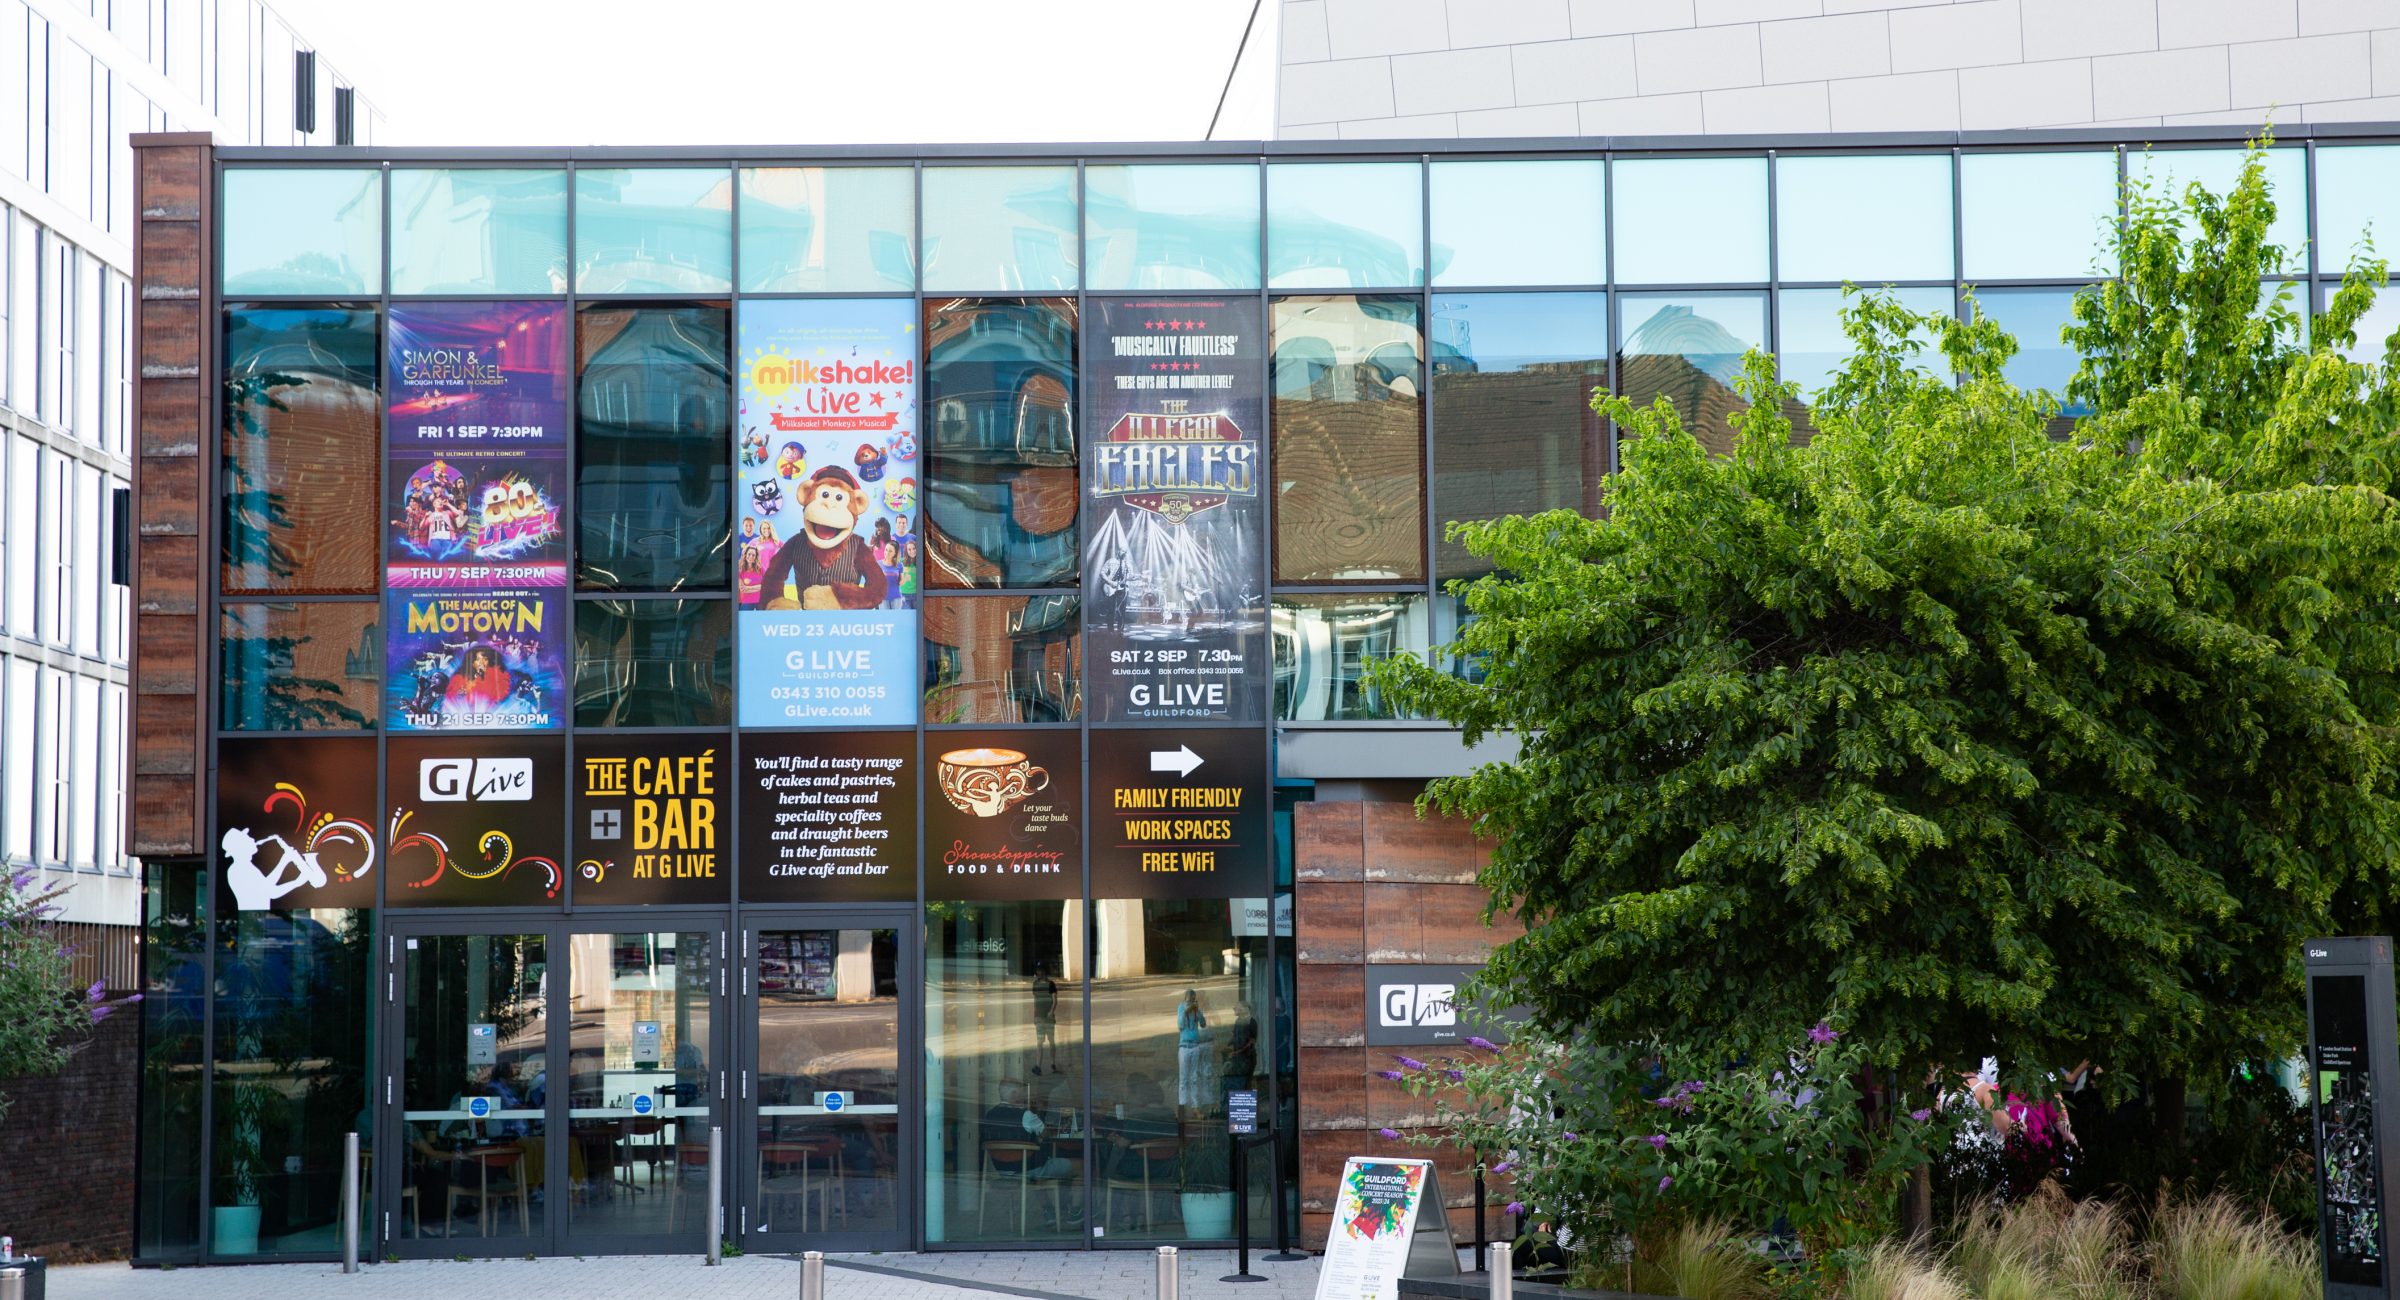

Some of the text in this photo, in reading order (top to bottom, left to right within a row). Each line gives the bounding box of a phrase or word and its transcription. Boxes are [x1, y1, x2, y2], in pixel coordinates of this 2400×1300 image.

[404, 350, 479, 365] SIMON &
[404, 366, 504, 380] GARFUNKEL
[758, 360, 913, 384] milkshake!
[1137, 376, 1155, 389] GUYS
[1156, 376, 1168, 389] ARE
[1169, 376, 1179, 389] ON
[1181, 375, 1210, 389] ANOTHER
[1161, 400, 1188, 414] THE
[782, 419, 887, 428] Milkshake! Monkey's Musical
[1129, 416, 1224, 440] ILLEGAL
[418, 426, 543, 438] FRI 1 SEP 7:30PM
[1099, 445, 1252, 493] EAGLES
[1169, 501, 1182, 509] 50
[478, 512, 556, 546] LIVE!
[411, 568, 545, 579] THU 7 SEP 7:30PM
[439, 600, 516, 611] THE MAGIC OF
[408, 601, 544, 633] MOTOWN
[763, 624, 894, 636] WED 23 AUGUST
[786, 651, 871, 670] G LIVE
[1111, 651, 1139, 662] SAT
[1144, 651, 1153, 662] 2
[1158, 651, 1187, 662] SEP
[771, 687, 885, 699] 0343 310 0055
[1130, 684, 1224, 705] G LIVE
[785, 704, 872, 717] GLive.co.uk
[405, 714, 549, 725] THU 21 SEP 7:30PM
[755, 757, 903, 771] You'll find a tasty range
[586, 749, 715, 795] THE CAFÉ
[761, 774, 896, 790] of cakes and pastries,
[779, 792, 878, 804] herbal teas and
[1114, 788, 1242, 808] FAMILY FRIENDLY
[1034, 805, 1052, 813] your
[634, 799, 715, 849] BAR
[775, 809, 882, 825] speciality coffees
[771, 827, 888, 842] and draught beers
[1125, 820, 1231, 840] WORK SPACES
[780, 845, 877, 860] in the fantastic
[944, 840, 1064, 869] Showstopping
[633, 854, 715, 878] AT G LIVE
[948, 864, 1060, 874] FOOD & DRINK
[1143, 852, 1215, 872] FREE WiFi
[770, 863, 889, 878] G Live café and bar
[2310, 949, 2327, 957] G-Live
[1364, 1175, 1407, 1184] GUILDFORD
